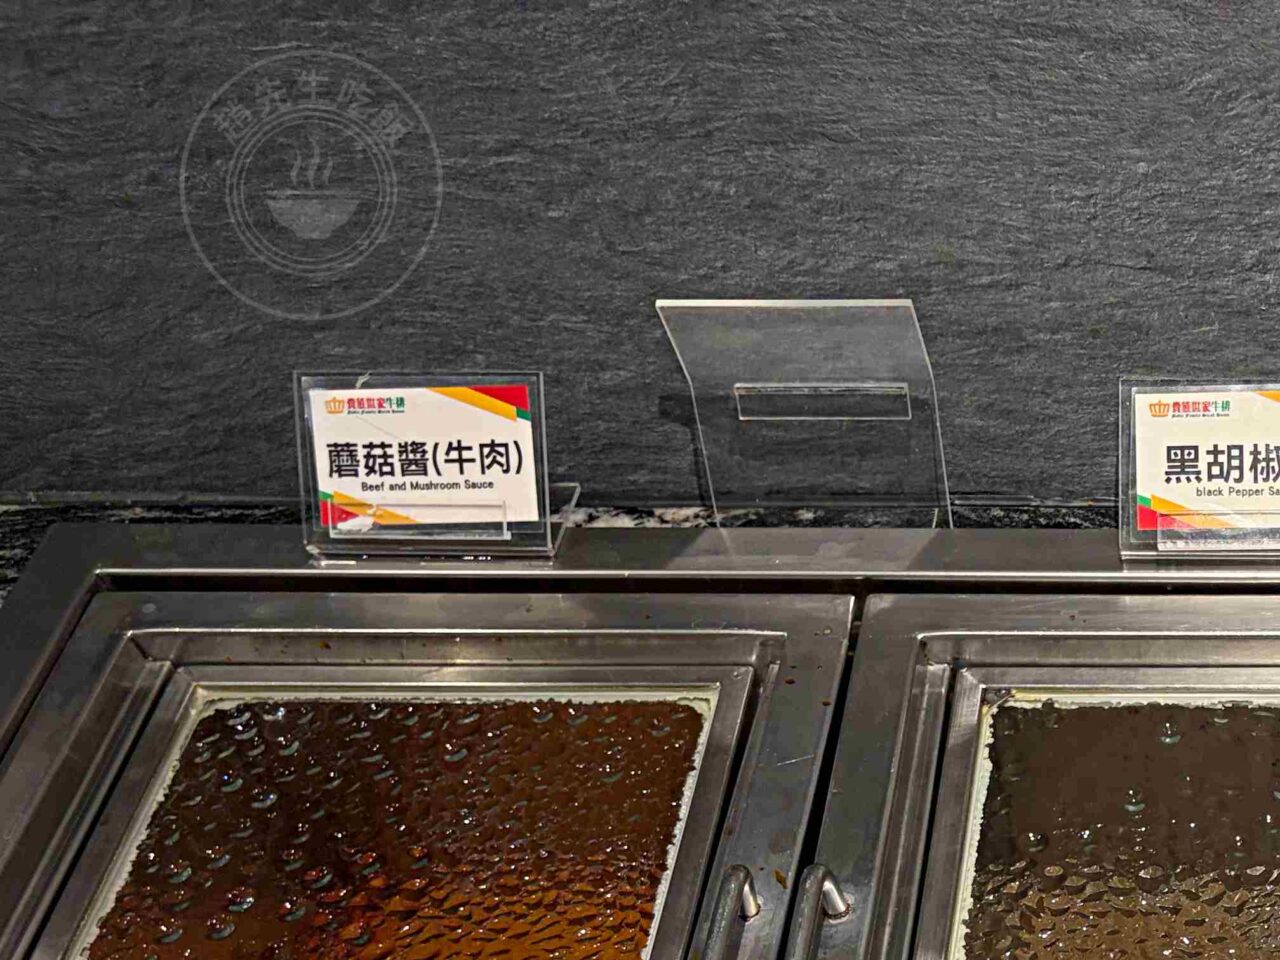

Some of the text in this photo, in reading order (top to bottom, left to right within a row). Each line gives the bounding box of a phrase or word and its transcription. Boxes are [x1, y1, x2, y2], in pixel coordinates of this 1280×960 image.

[326, 439, 523, 479] 蘑菇醬(牛肉)
[361, 480, 494, 492] Beef and Mushroom Sauce
[1196, 487, 1224, 497] black
[1229, 487, 1264, 498] Pepper
